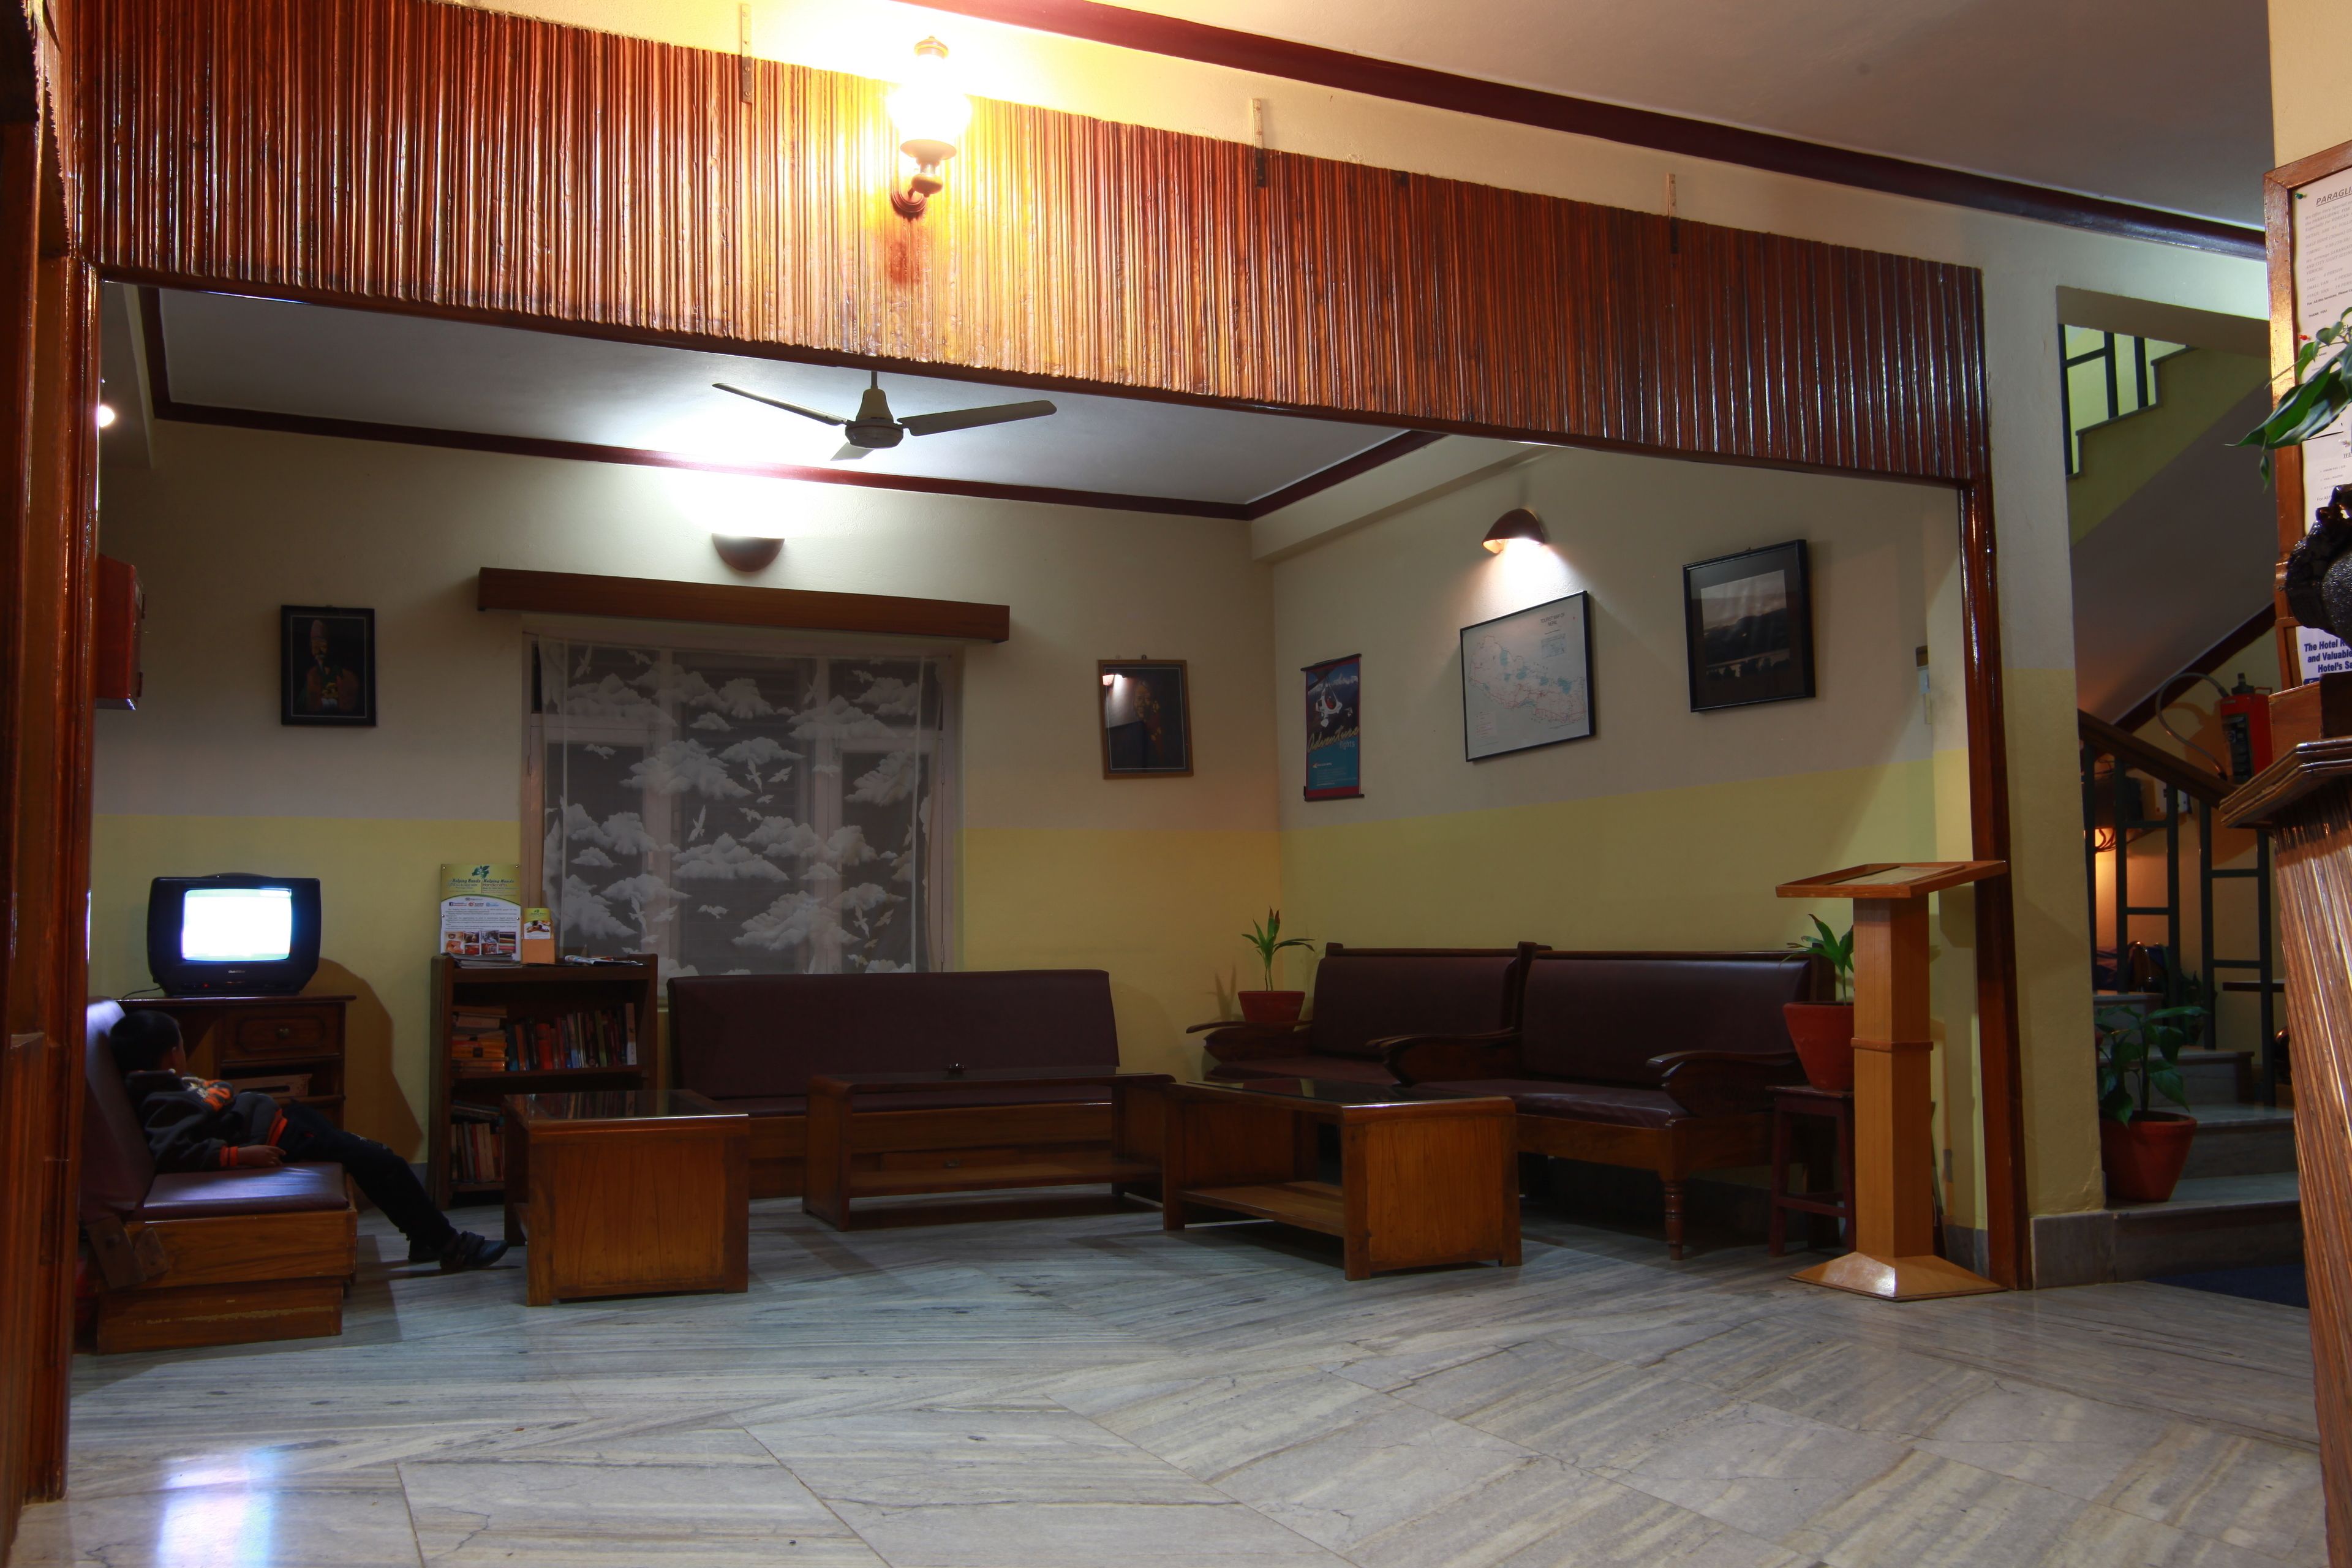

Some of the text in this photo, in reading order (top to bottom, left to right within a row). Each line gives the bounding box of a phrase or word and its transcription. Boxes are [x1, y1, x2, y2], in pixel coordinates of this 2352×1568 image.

[2327, 267, 2343, 276] PERSON
[2304, 643, 2317, 652] The
[2319, 639, 2338, 650] Hotel
[2307, 653, 2320, 663] and
[2318, 662, 2343, 673] Hotel's
